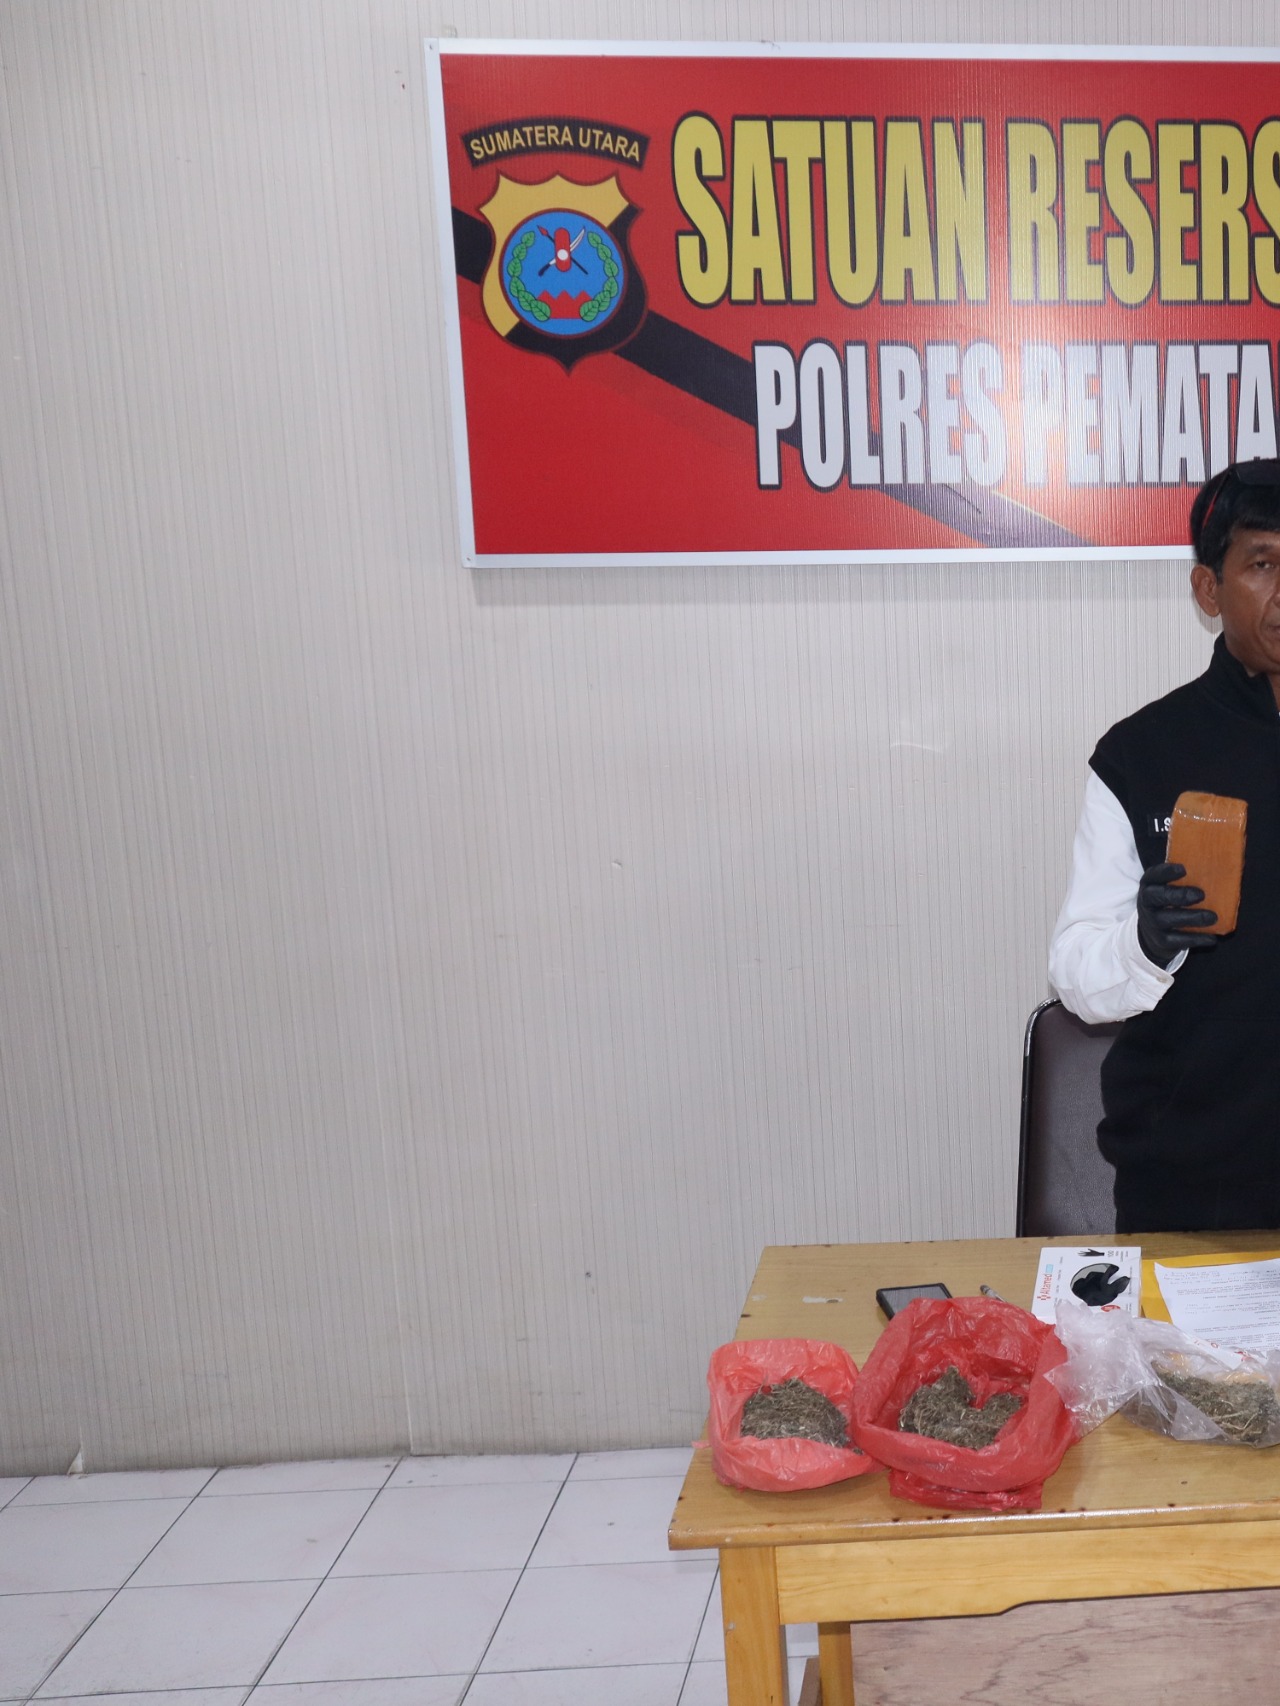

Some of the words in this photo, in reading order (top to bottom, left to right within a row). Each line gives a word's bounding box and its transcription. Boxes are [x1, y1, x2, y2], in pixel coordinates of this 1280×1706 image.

[470, 125, 573, 159] SUMATERA
[579, 127, 640, 162] UTARA
[672, 113, 988, 306] SATUAN
[753, 340, 1006, 489] POLRES
